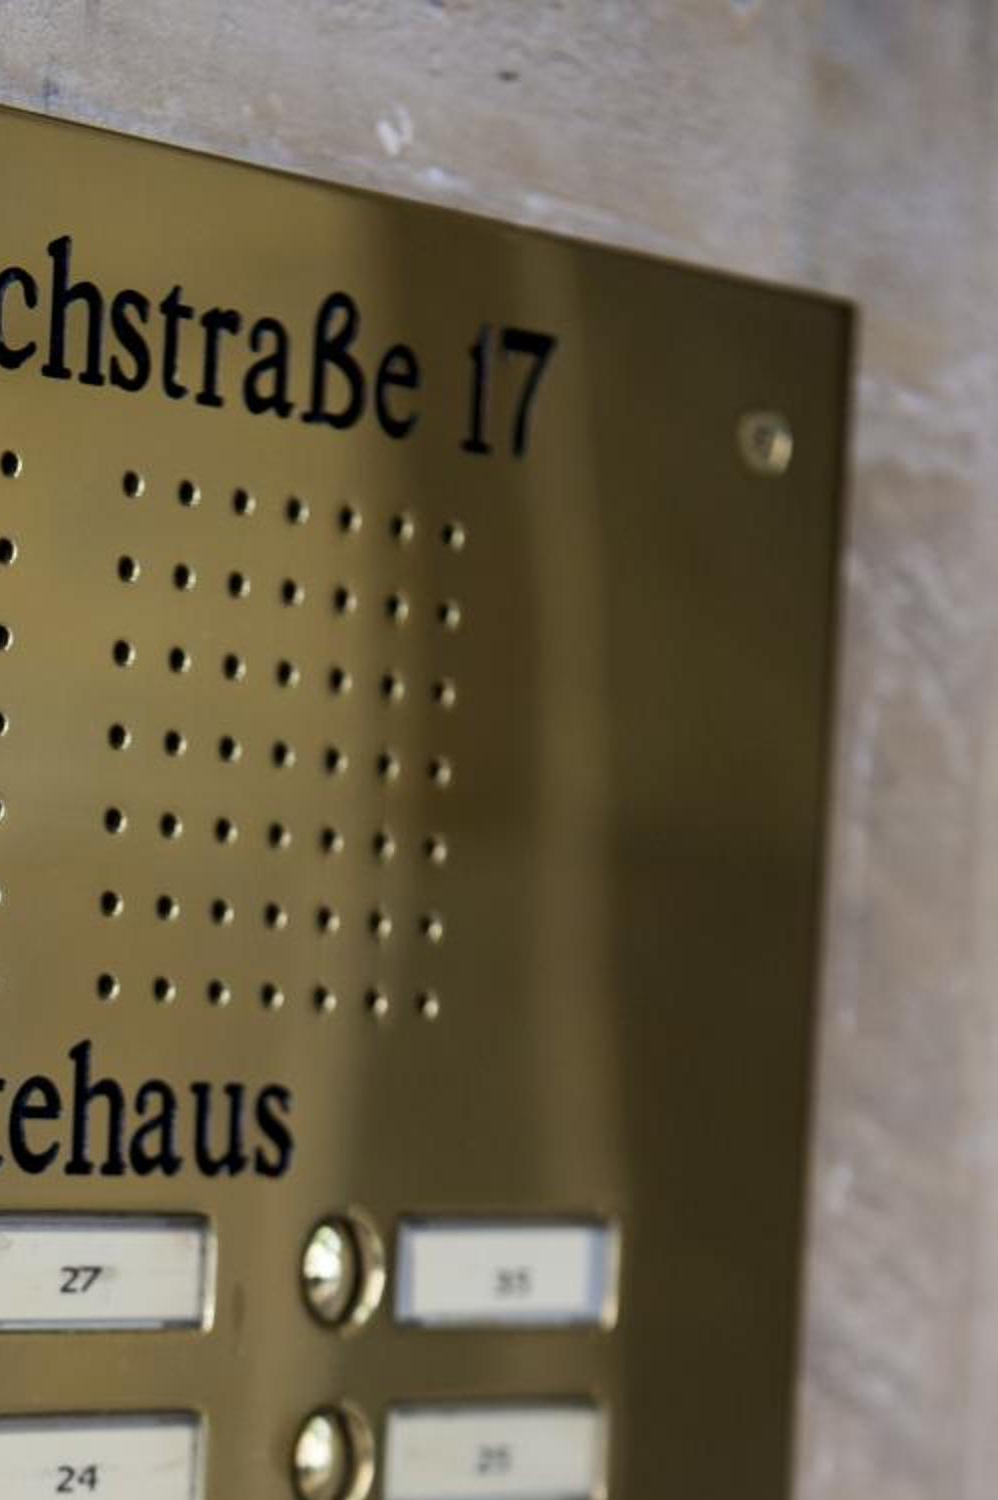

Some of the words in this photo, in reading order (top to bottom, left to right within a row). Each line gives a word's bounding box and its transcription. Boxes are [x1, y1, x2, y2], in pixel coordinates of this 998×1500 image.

[460, 321, 558, 458] 17
[58, 1264, 104, 1294] 27
[55, 1465, 99, 1494] 24
